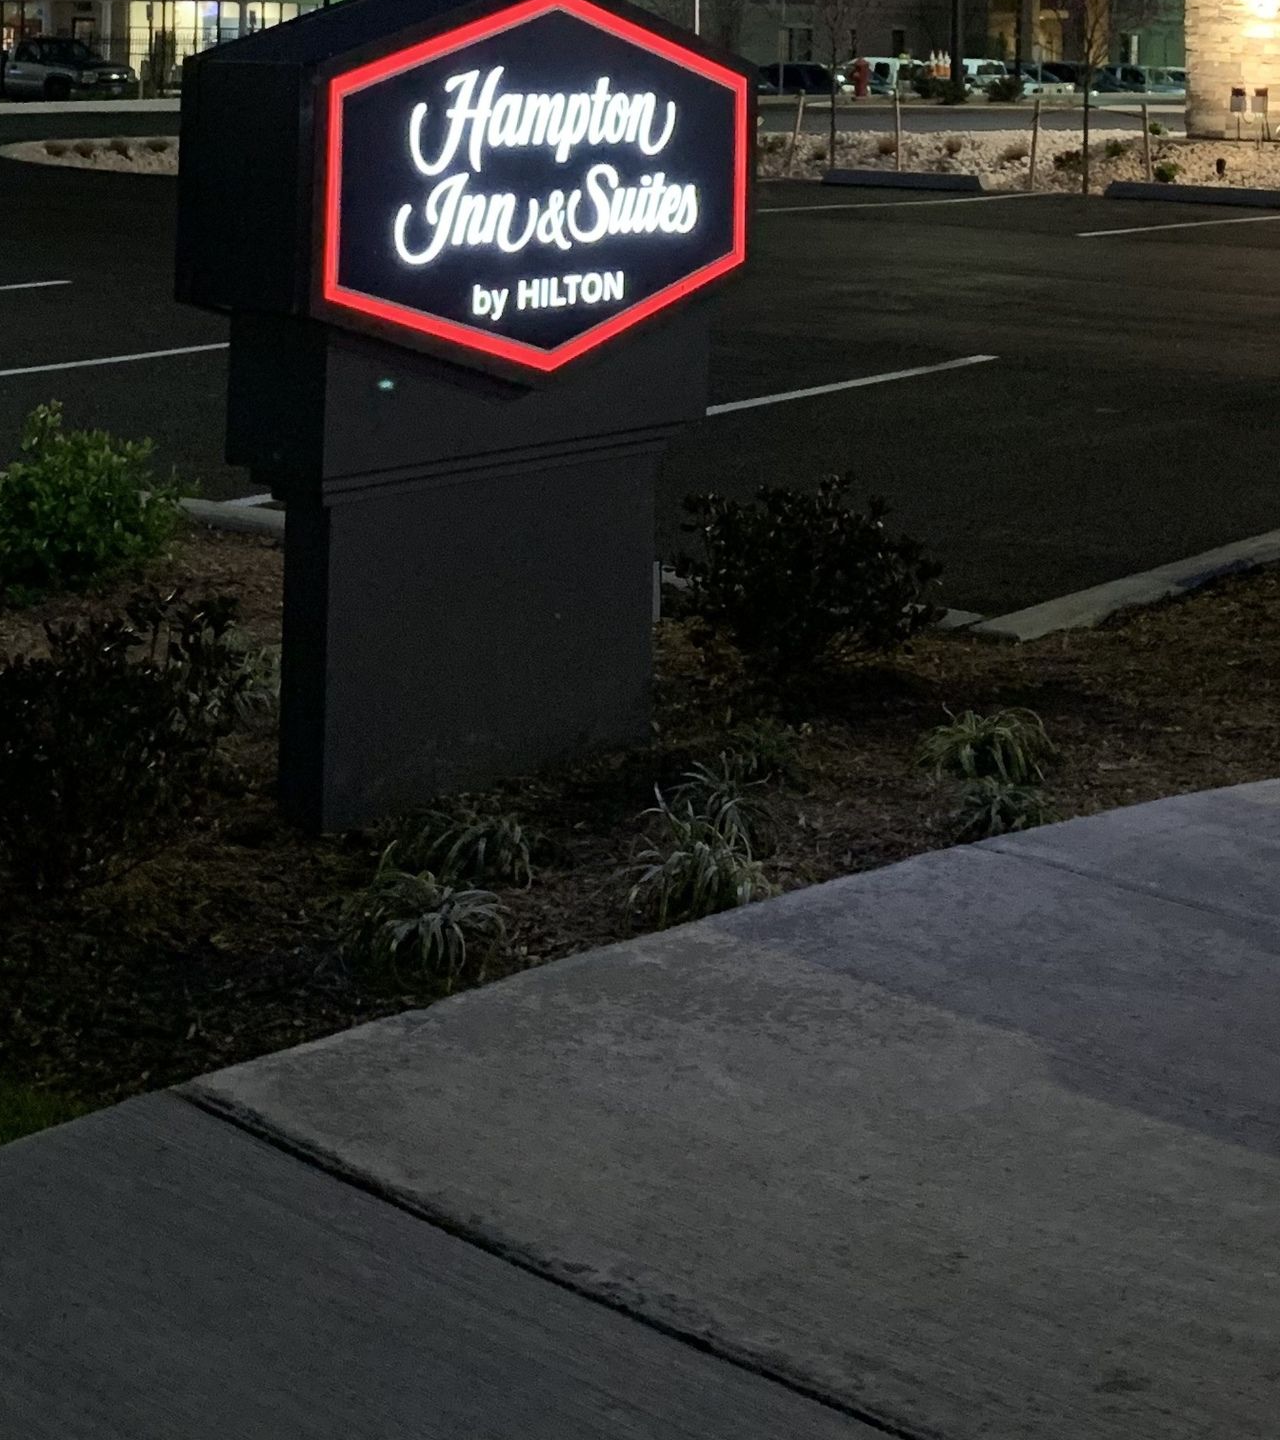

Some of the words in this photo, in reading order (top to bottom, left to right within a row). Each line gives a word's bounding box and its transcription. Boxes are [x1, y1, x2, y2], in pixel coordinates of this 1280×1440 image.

[409, 65, 676, 176] Hampton
[393, 172, 539, 264] Inn
[538, 189, 572, 250] &
[567, 163, 699, 243] Suites
[473, 284, 509, 320] by
[518, 270, 625, 310] HILTON
